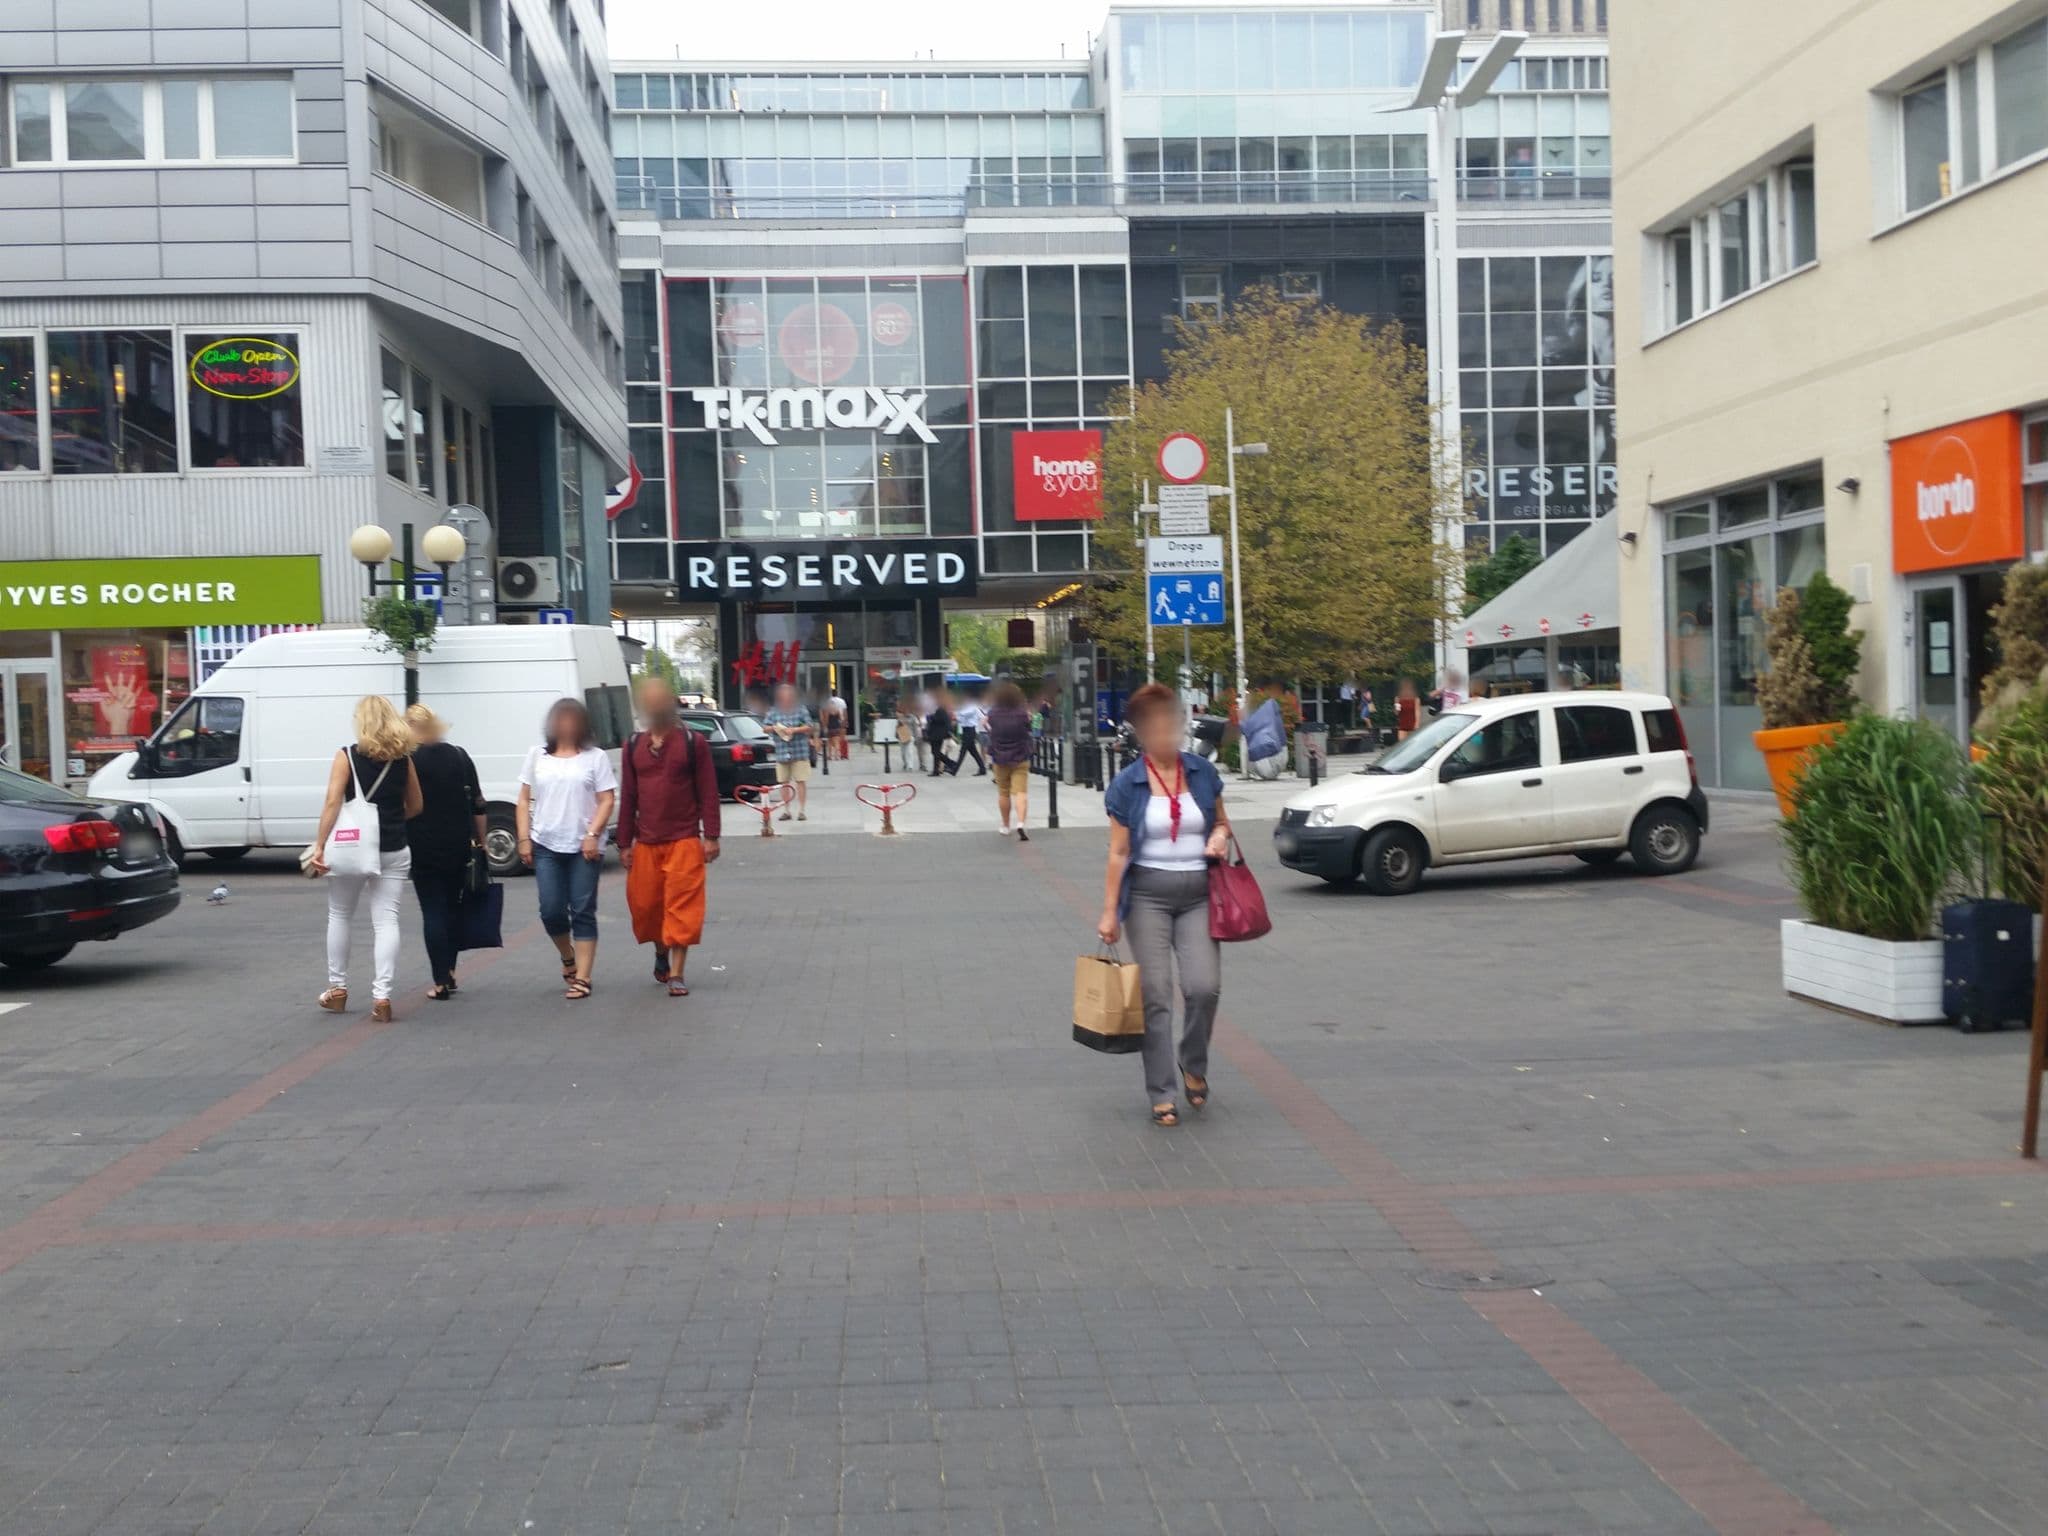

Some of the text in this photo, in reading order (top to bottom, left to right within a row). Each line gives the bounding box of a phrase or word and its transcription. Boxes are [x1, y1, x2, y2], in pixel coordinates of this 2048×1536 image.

[241, 349, 287, 366] Open
[1033, 455, 1097, 476] home
[1043, 474, 1098, 498] &you
[1917, 472, 1975, 521] bordo
[1167, 541, 1204, 553] Droga
[688, 552, 966, 590] RESERVED
[7, 582, 237, 606] YVES ROCHER
